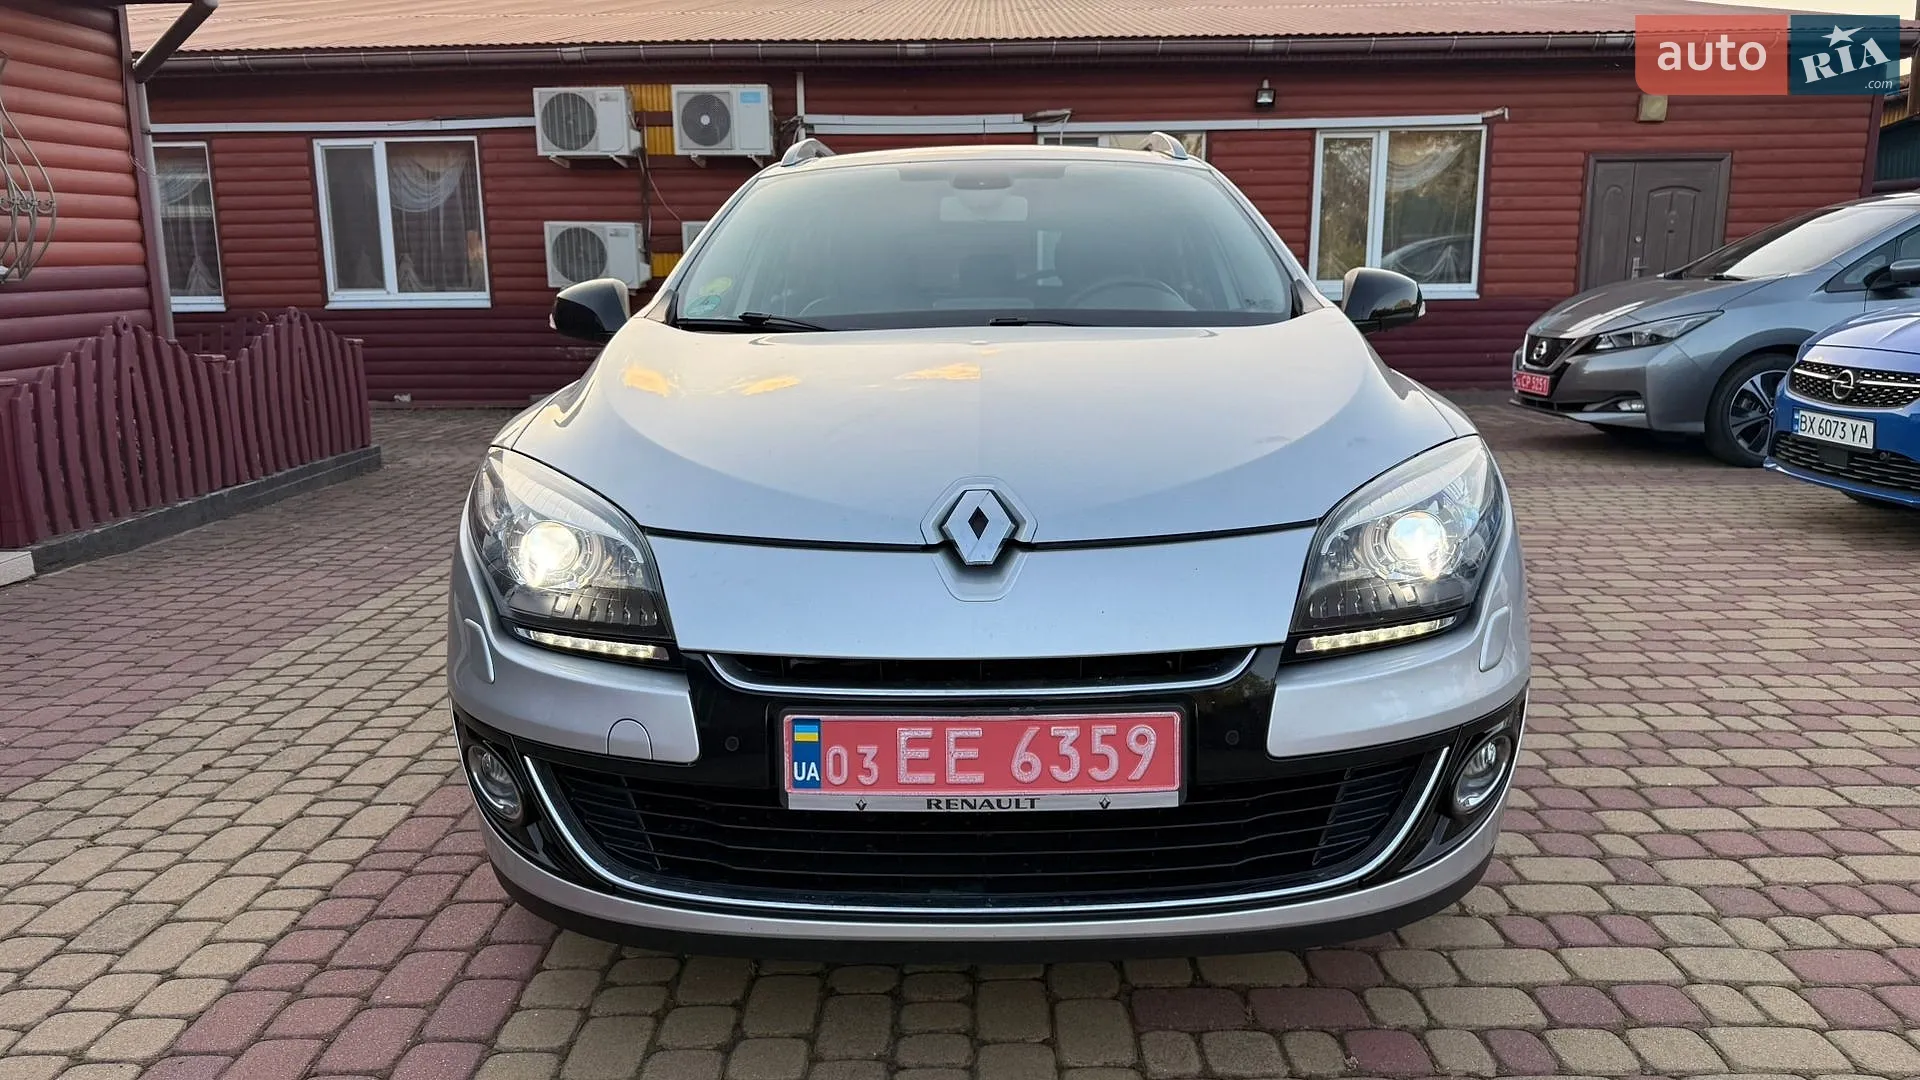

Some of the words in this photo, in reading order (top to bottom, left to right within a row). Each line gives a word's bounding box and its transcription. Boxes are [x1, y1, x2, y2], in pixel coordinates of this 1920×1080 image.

[1800, 414, 1816, 435] BX
[1818, 418, 1846, 440] 6073
[1850, 423, 1868, 444] YA
[793, 762, 820, 781] UA
[826, 745, 879, 786] 03
[896, 727, 985, 785] EE
[1010, 724, 1157, 783] 6359
[926, 797, 1041, 810] RENAULT
